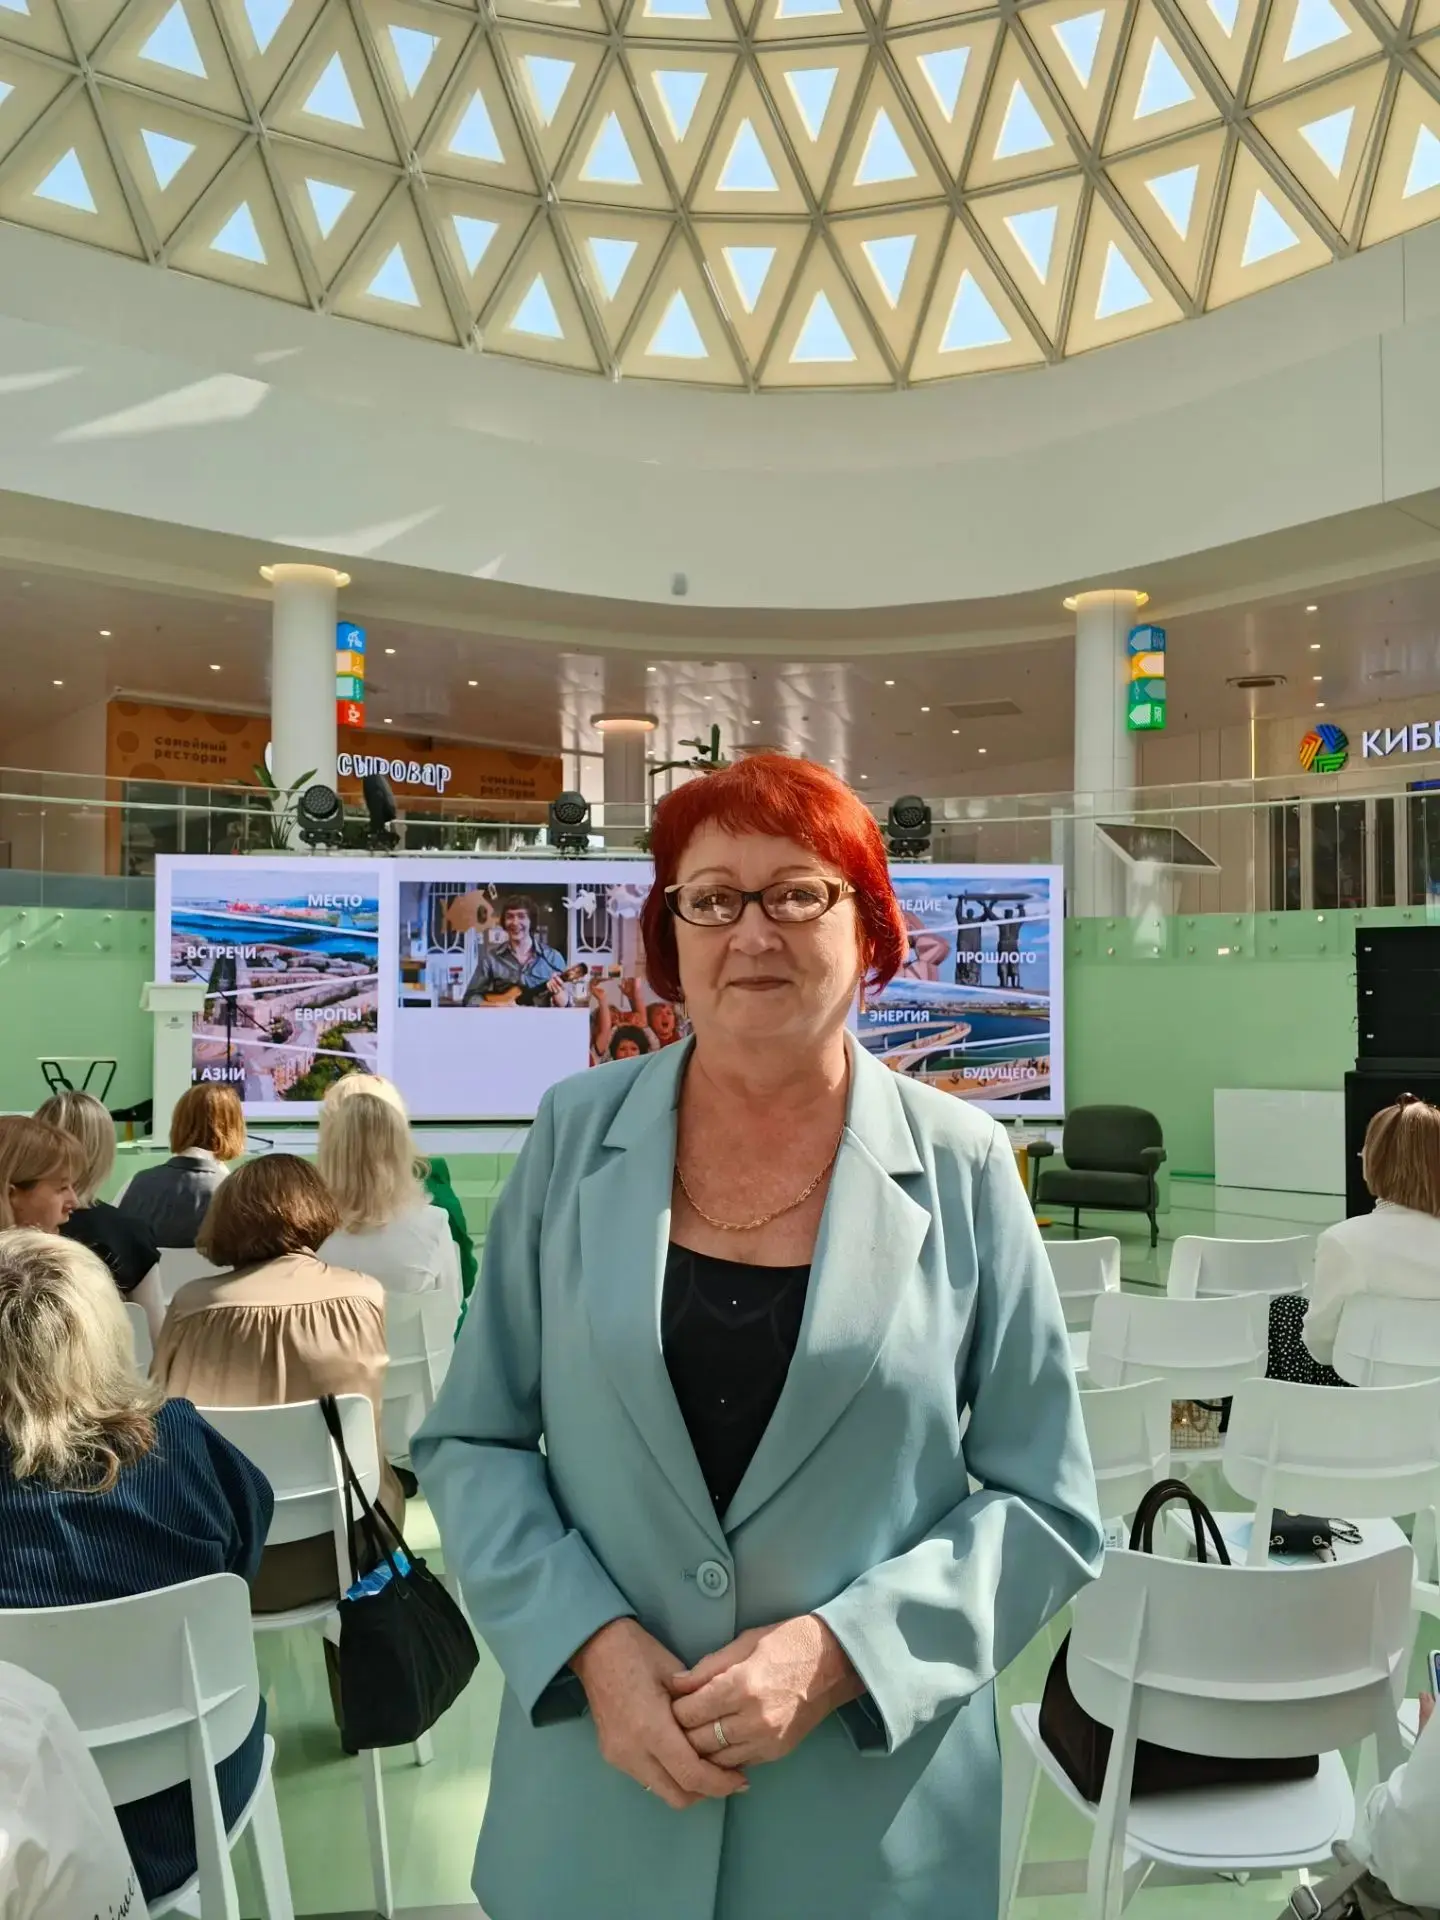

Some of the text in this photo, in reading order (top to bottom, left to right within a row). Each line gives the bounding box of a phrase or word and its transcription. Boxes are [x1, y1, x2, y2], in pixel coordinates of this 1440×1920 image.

[154, 749, 227, 765] ресторан
[307, 893, 363, 908] МЕСТО
[186, 945, 257, 960] ВСТРЕЧИ
[956, 951, 1037, 964] ПРОШЛОГО
[295, 1007, 362, 1021] ЕВРОПЫ
[868, 1009, 930, 1022] ЭНЕРГИЯ
[200, 1067, 246, 1081] АЗИИ
[963, 1066, 1037, 1081] БУДУЩЕГО
